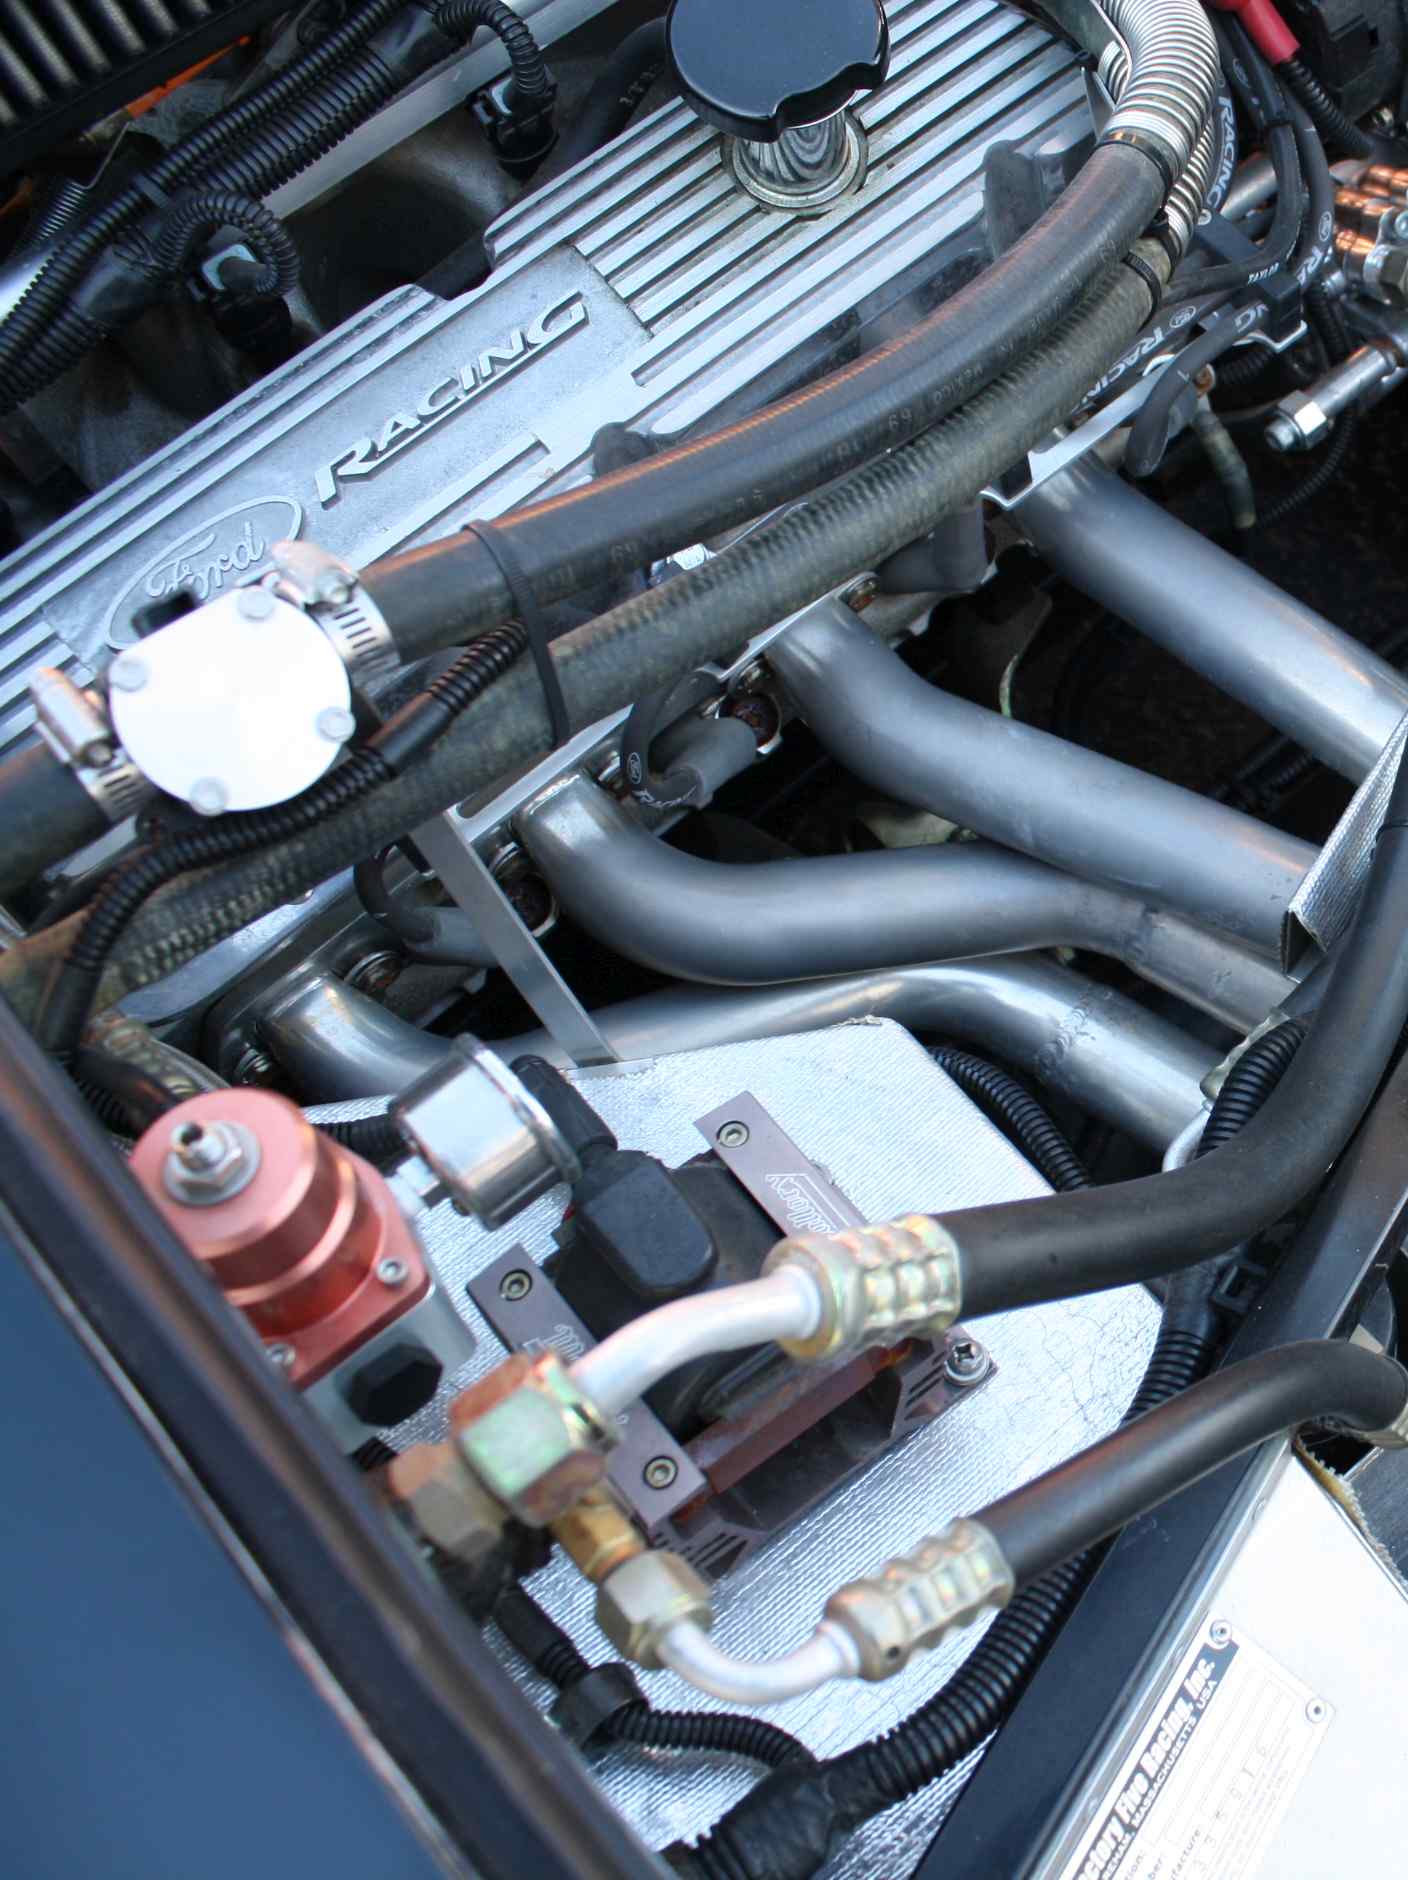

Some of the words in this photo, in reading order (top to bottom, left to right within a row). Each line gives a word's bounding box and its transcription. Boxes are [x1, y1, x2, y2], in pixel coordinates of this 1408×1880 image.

[314, 288, 590, 510] RACING
[1081, 327, 1165, 404] RACIN
[146, 519, 267, 602] Ford
[1114, 1773, 1150, 1826] Five
[1184, 1658, 1216, 1701] Inc.
[1131, 1715, 1197, 1828] MASSACHUSETTS
[1196, 1679, 1218, 1710] USA
